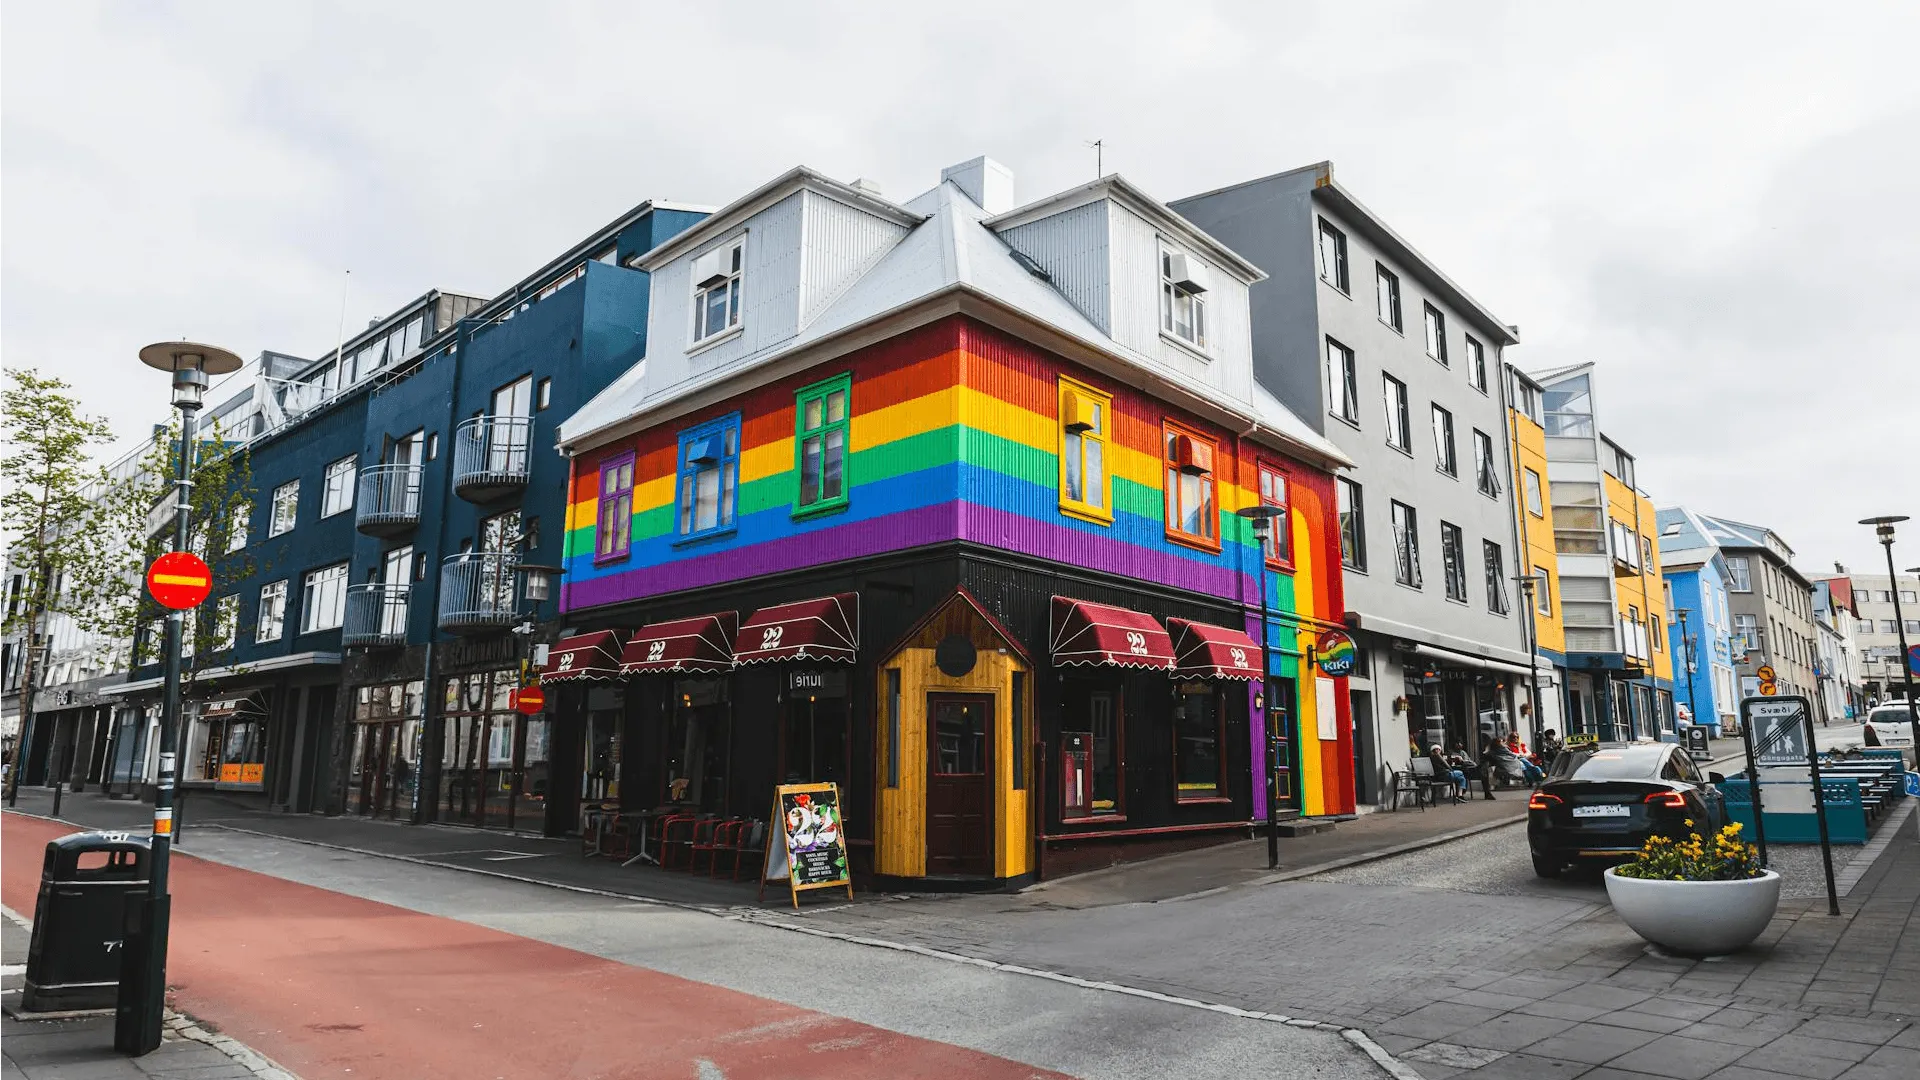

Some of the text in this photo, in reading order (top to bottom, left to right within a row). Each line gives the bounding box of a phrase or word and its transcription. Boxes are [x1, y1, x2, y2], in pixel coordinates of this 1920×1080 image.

[760, 626, 784, 650] 22
[1127, 631, 1149, 655] 22
[647, 641, 667, 661] 22
[1230, 647, 1249, 669] 22
[558, 652, 575, 672] 22
[1324, 661, 1350, 671] KIKI
[1906, 775, 1912, 792] P
[787, 805, 837, 849] 22
